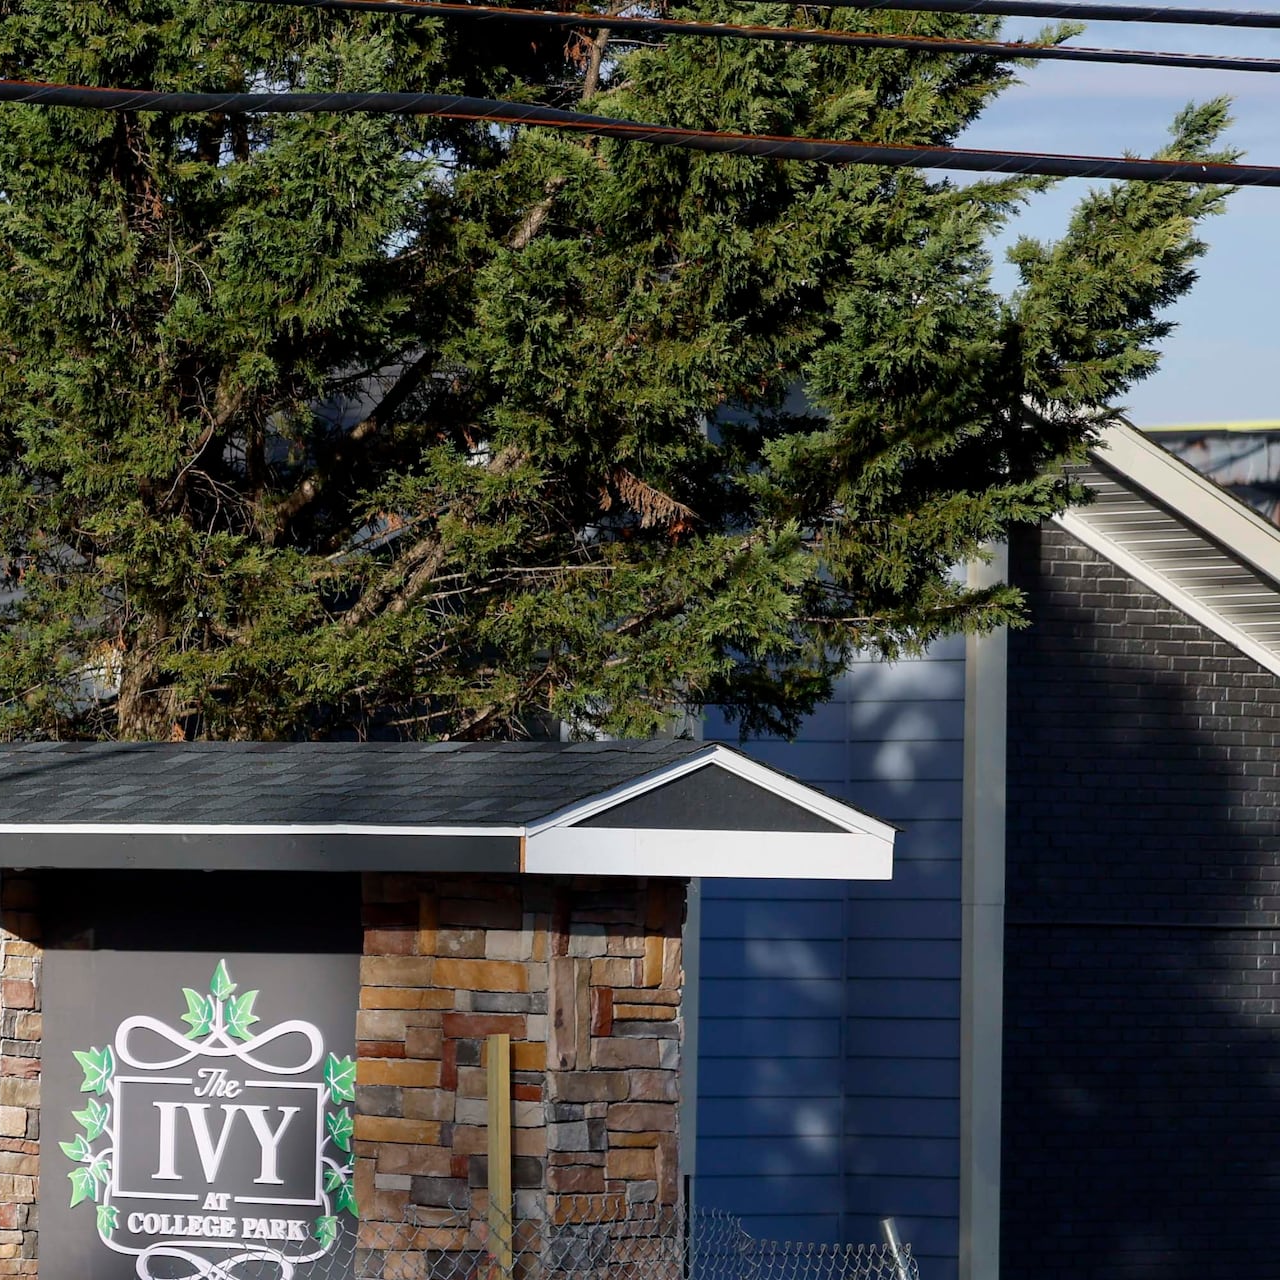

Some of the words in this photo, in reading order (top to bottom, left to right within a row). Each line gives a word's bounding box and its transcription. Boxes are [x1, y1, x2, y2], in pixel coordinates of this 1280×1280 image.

[194, 1068, 243, 1098] The
[151, 1101, 301, 1185] IVY
[202, 1192, 231, 1211] AT
[127, 1212, 237, 1238] COLLEGE
[241, 1217, 307, 1241] PARK
